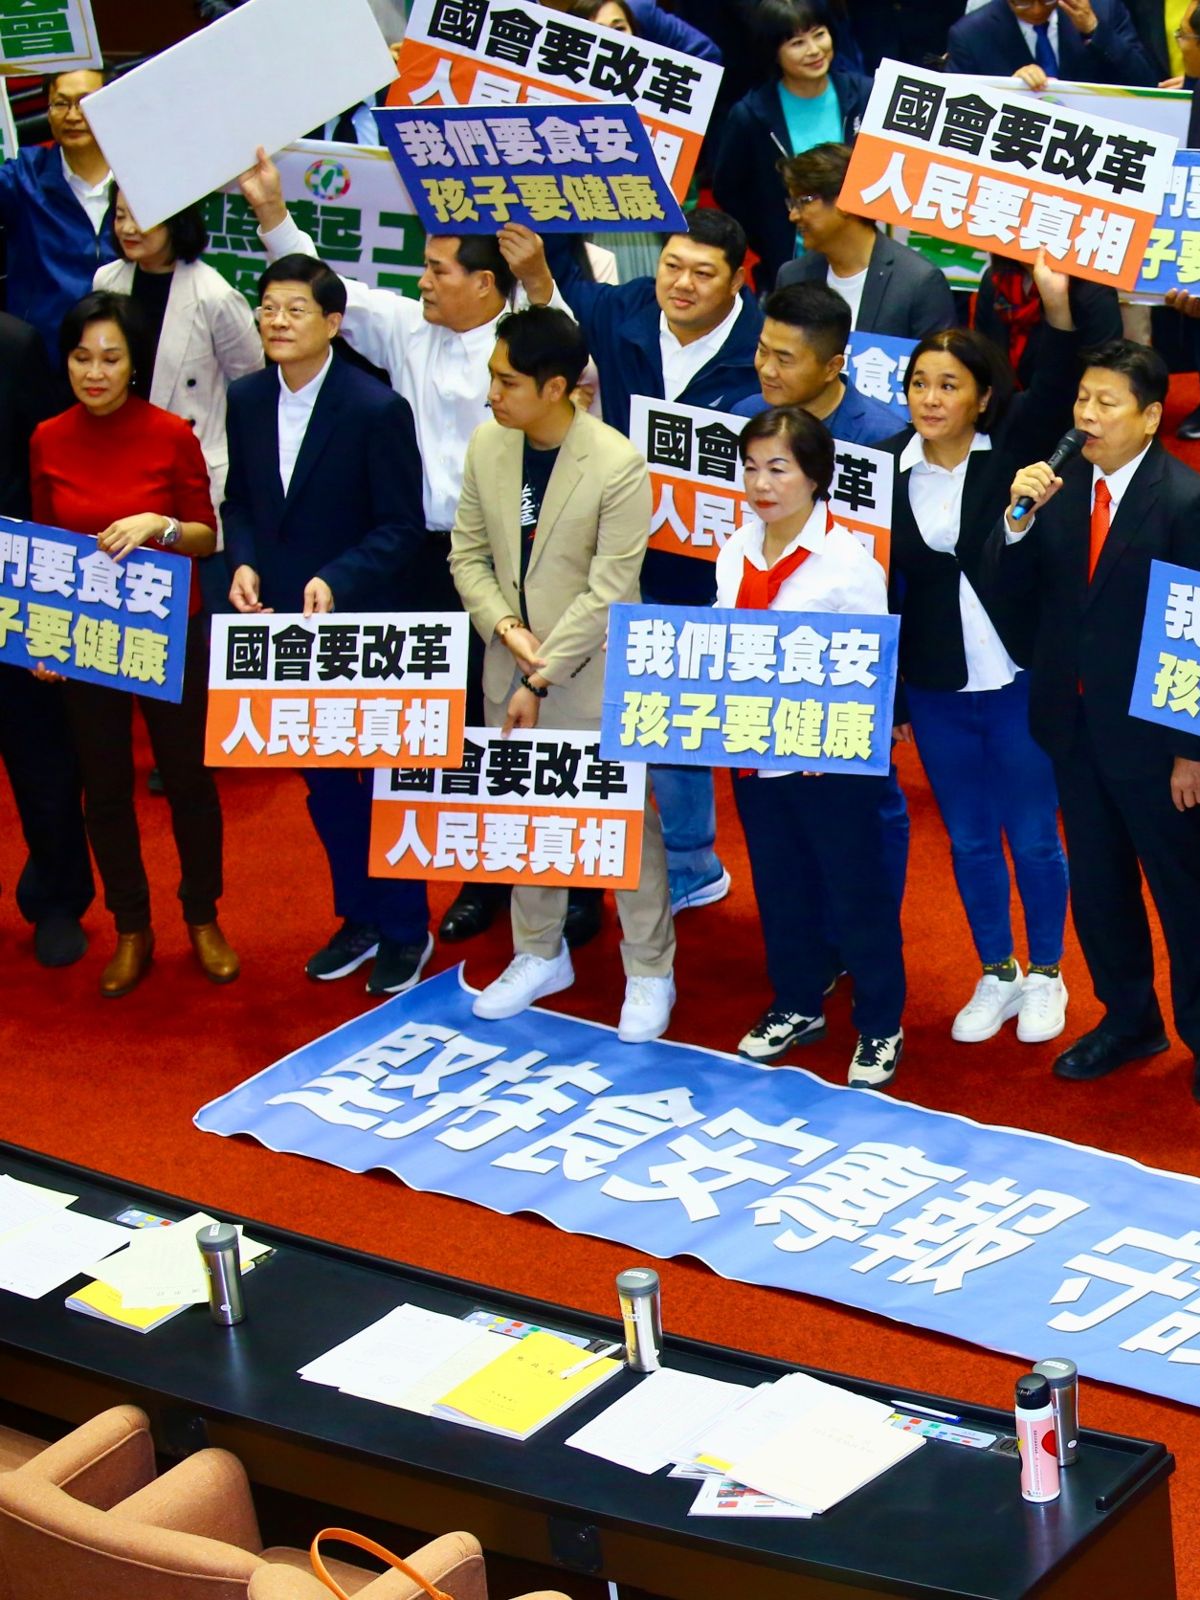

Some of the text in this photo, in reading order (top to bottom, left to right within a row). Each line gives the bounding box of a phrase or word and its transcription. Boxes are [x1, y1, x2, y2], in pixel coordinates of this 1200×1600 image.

[427, 0, 702, 115] 國會要改革
[394, 116, 640, 168] 我們要食安
[882, 75, 1157, 195] 國會要改革
[420, 173, 666, 224] 孩子要健康
[860, 151, 1136, 275] 人民要真相
[647, 409, 878, 512] 國會革
[226, 624, 452, 681] 國會要改革
[626, 619, 881, 688] 我們要食安
[220, 697, 451, 757] 人民要真相
[620, 691, 876, 761] 孩子要健康
[384, 808, 628, 877] 人民要真相
[264, 1020, 1091, 1296] 堅持食安專報
